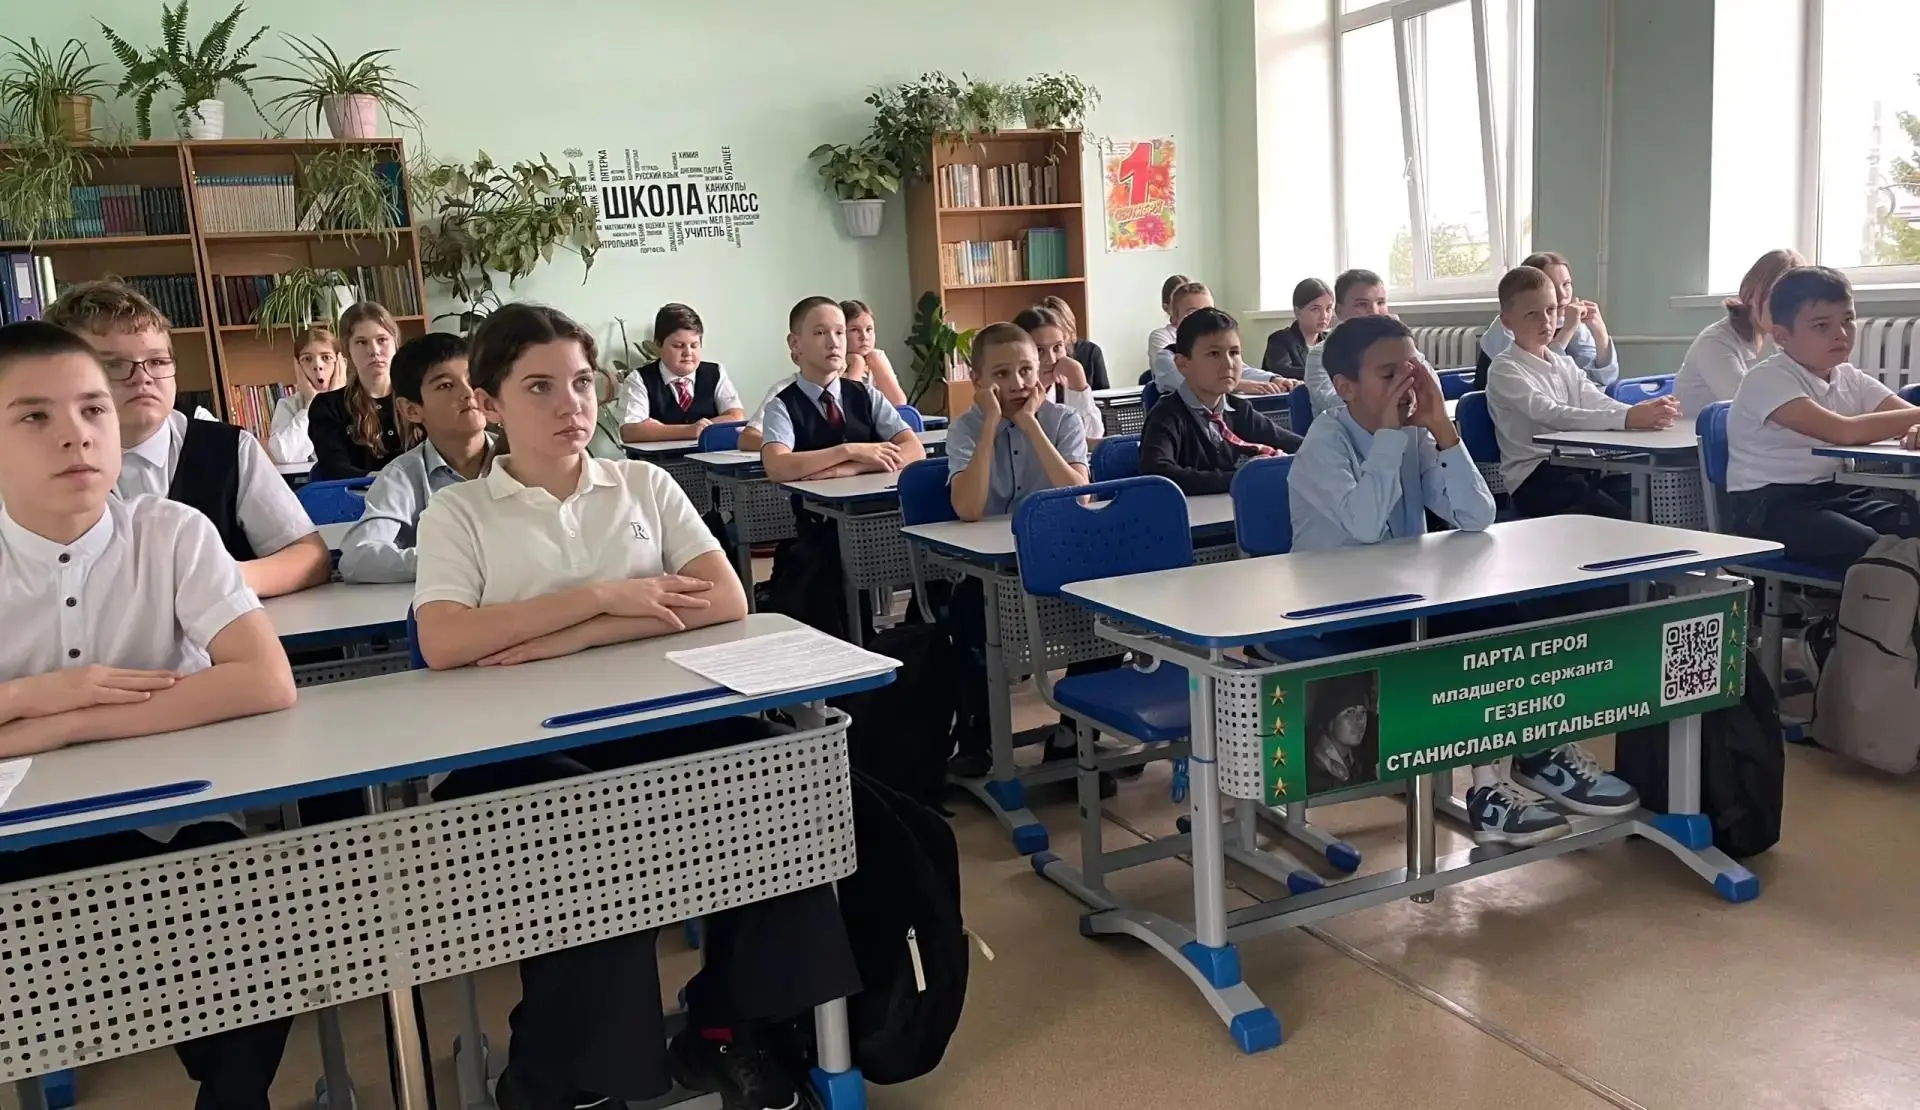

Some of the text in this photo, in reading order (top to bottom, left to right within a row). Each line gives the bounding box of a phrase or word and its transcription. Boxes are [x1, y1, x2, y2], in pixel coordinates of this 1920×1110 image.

[598, 149, 610, 181] ПЯТЕРКА
[635, 171, 661, 180] РУССКИЙ
[662, 171, 679, 179] ЯЗЫК
[704, 166, 722, 174] ПАРТА
[722, 145, 733, 180] БУДУЩЕЕ
[1119, 142, 1153, 206] 1
[602, 183, 703, 219] ШКОЛА
[705, 182, 746, 192] КАНИКУЛЫ
[707, 193, 759, 214] КЛАСС
[685, 226, 725, 238] УЧИТЕЛЬ
[709, 215, 723, 224] МЕЛ
[1463, 633, 1588, 671] ПАРТА ГЕРОЯ
[1432, 657, 1613, 705] младшего сержанта
[1484, 693, 1566, 723] ГЕЗЕНКО
[1387, 702, 1650, 771] СТАНИСЛАВА ВИТАЛЬЕВИЧА
